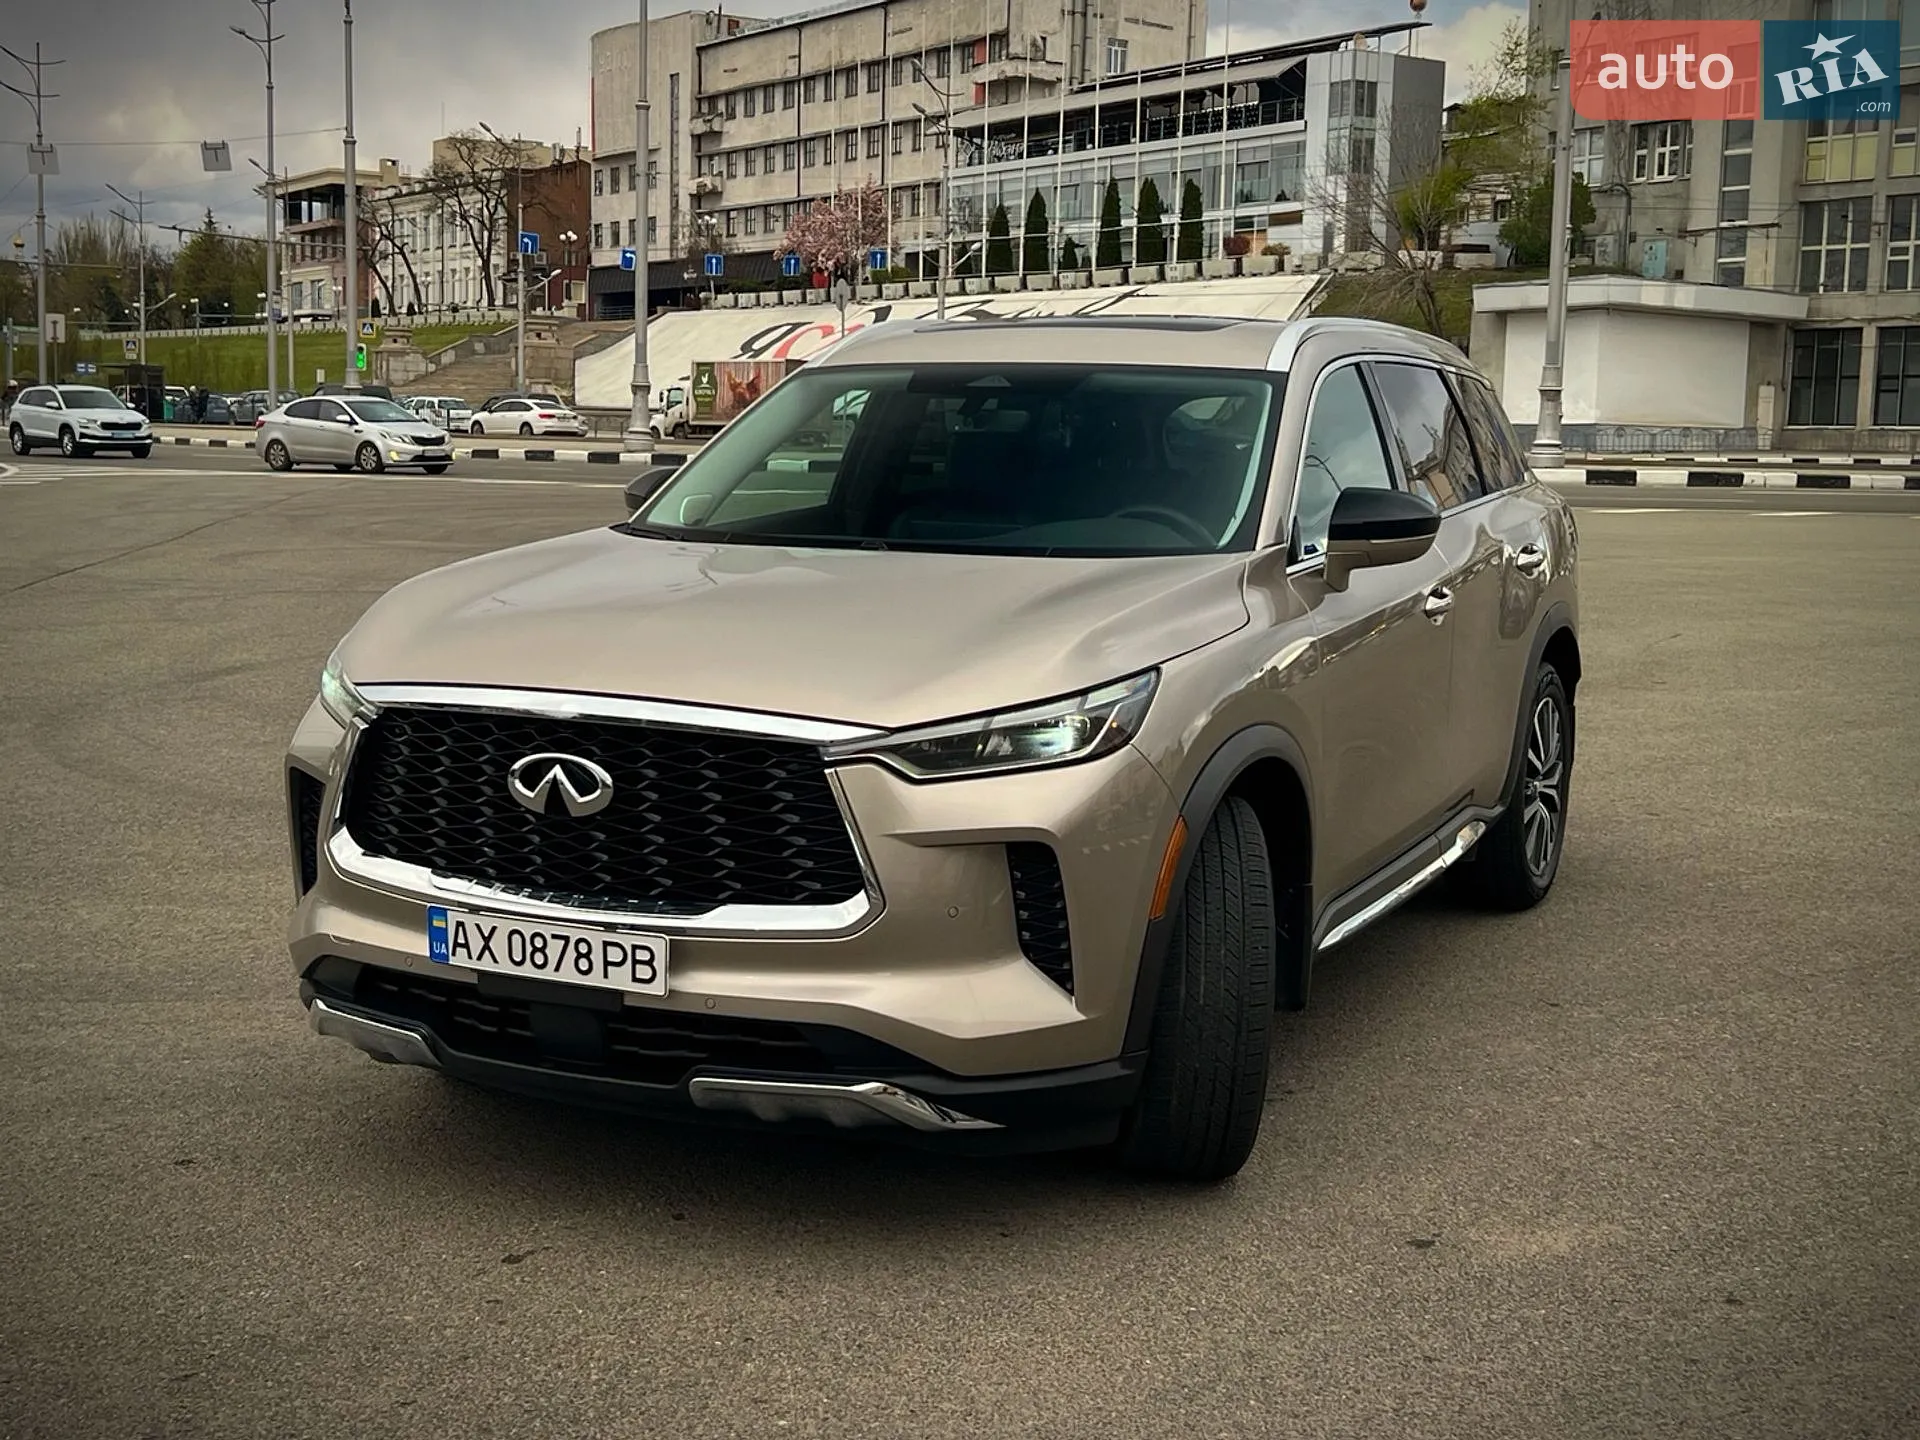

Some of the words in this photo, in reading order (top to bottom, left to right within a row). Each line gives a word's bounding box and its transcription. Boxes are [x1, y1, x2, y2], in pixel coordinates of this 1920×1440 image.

[433, 942, 447, 955] UA
[451, 920, 499, 964] AX
[507, 929, 593, 976] 0878
[602, 940, 658, 984] PB
